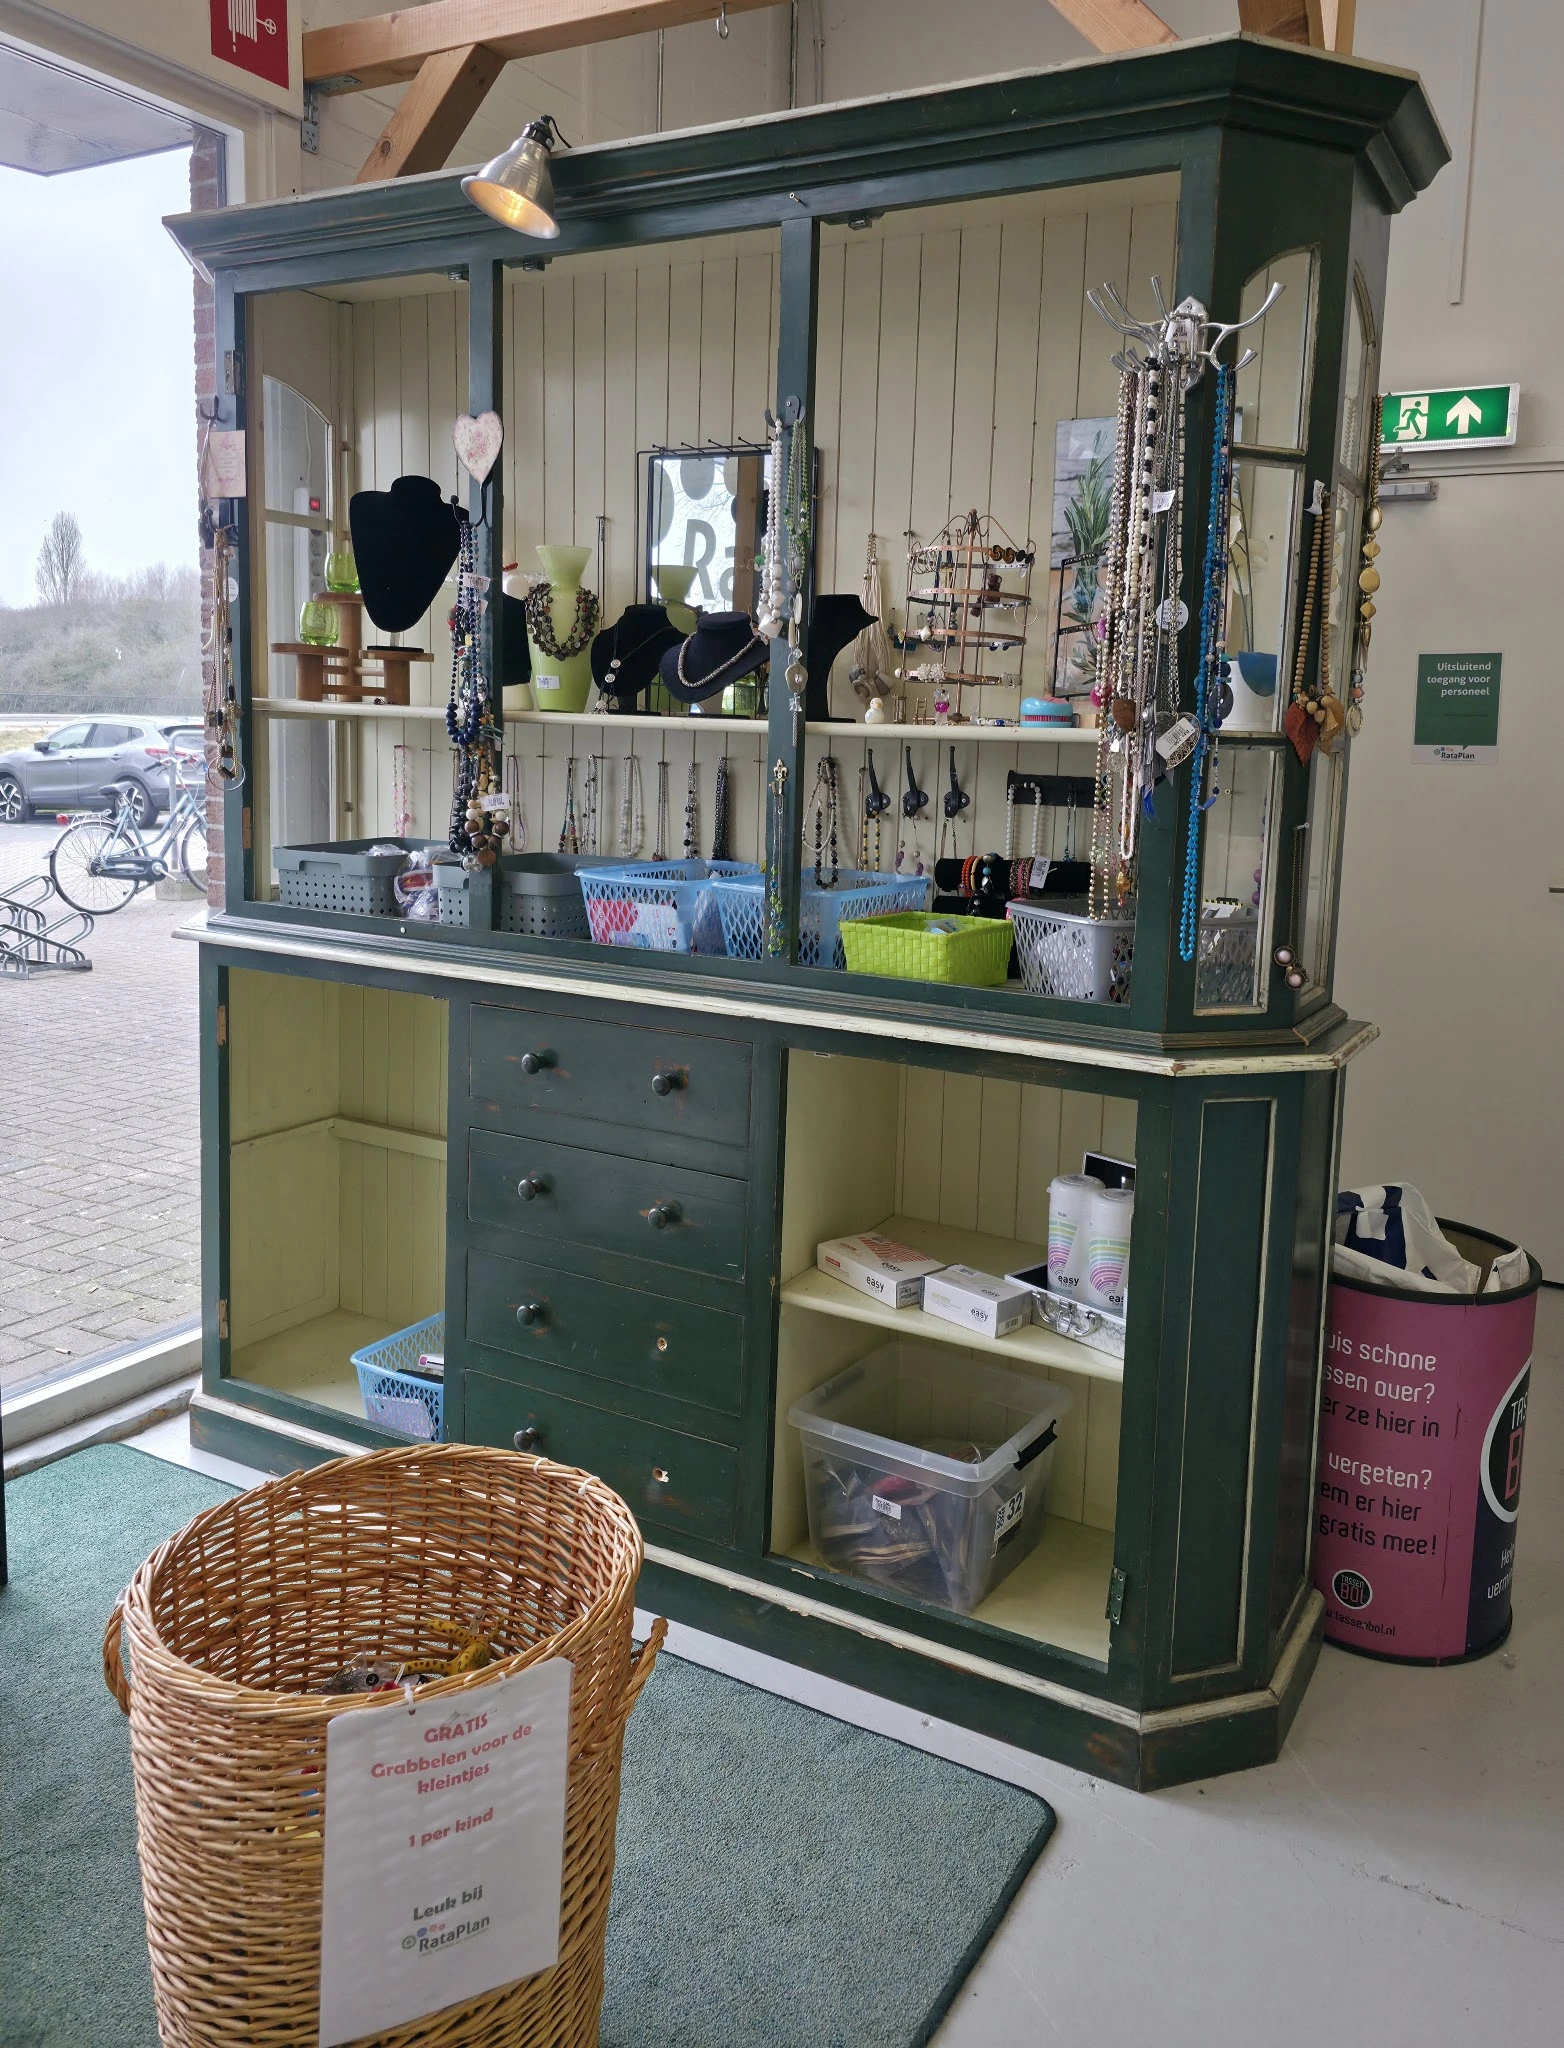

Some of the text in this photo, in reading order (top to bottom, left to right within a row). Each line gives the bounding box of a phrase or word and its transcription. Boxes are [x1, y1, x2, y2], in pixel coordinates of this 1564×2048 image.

[683, 518, 735, 601] Ra
[1427, 676, 1466, 685] toegang
[1437, 662, 1491, 671] Uitsluitend
[1441, 687, 1490, 697] personeel
[866, 1276, 885, 1293] easy
[1057, 1275, 1080, 1287] easy
[970, 1307, 989, 1322] easy
[1108, 1294, 1124, 1304] eas
[1328, 1330, 1437, 1372] uis schone
[1325, 1364, 1368, 1393] ssen
[1324, 1396, 1440, 1438] er ze hier in
[1504, 1426, 1523, 1500] B
[1006, 1491, 1023, 1521] 32
[1320, 1481, 1422, 1522] em er hier
[1319, 1513, 1437, 1556] gratis mee!
[1340, 1582, 1368, 1605] BOL
[1341, 1574, 1365, 1589] TASSEN
[423, 1712, 489, 1743] GRATIS
[371, 1724, 533, 1778] Grabbelen voor de
[417, 1762, 490, 1795] kleintjes
[408, 1806, 494, 1848] 1 per kind
[413, 1884, 483, 1921] Leuk bij
[419, 1915, 490, 1953] RataPlan
